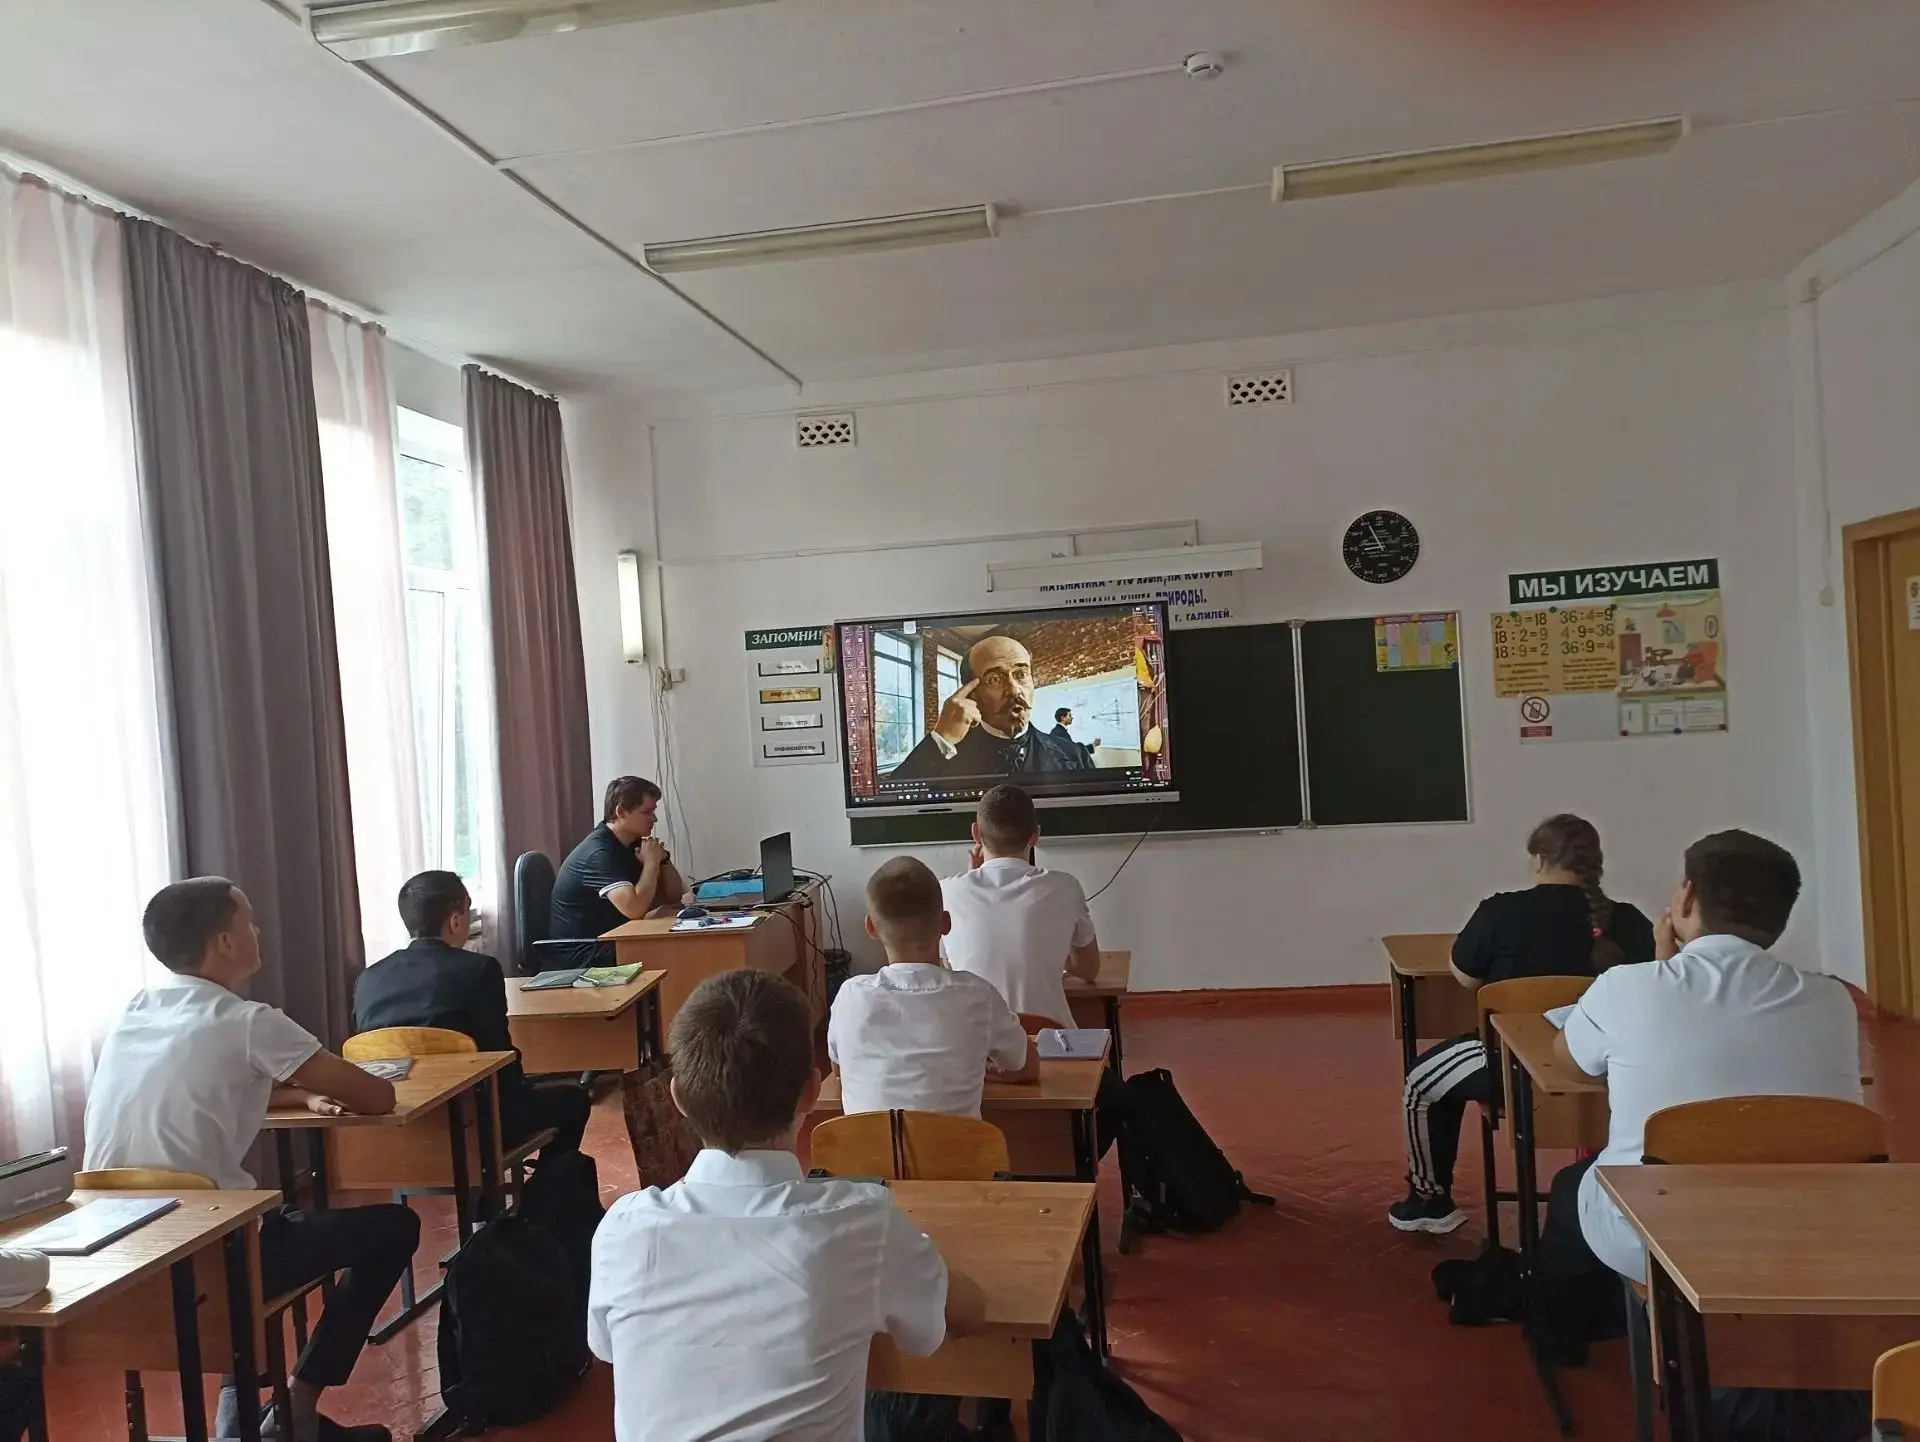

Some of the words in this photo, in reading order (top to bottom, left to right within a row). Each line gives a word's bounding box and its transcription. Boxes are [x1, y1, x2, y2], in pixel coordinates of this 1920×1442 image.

[1518, 576, 1566, 598] МЫ
[1575, 564, 1709, 594] ИЗУЧАЕМ
[752, 630, 822, 645] ЗАПОМНИ!
